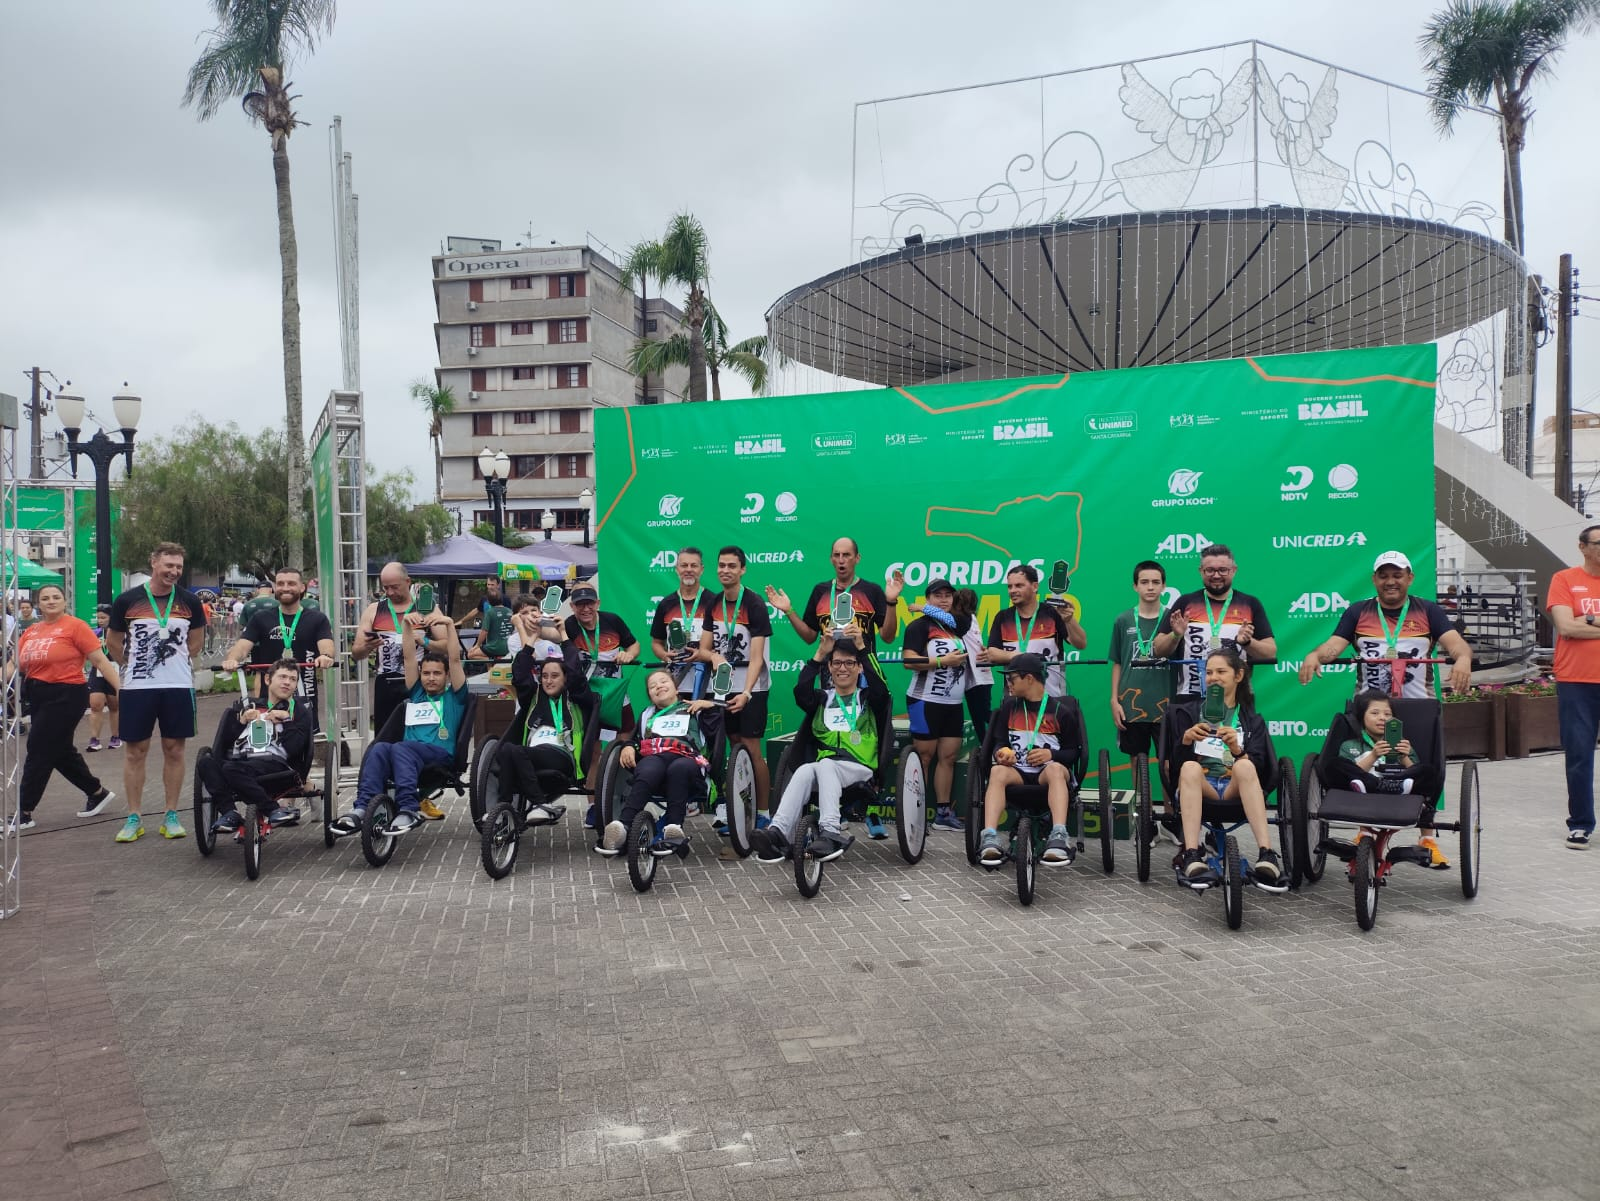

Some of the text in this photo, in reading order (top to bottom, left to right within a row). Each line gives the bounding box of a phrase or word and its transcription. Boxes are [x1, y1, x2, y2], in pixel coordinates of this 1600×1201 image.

[1298, 400, 1369, 420] BRASIL
[993, 422, 1053, 440] BRASIL
[1098, 420, 1133, 430] UNIMED
[734, 438, 786, 455] BRASIL
[823, 439, 853, 448] UNIMED
[1151, 496, 1214, 508] GRUPO KOCH
[1281, 492, 1308, 501] NDTV
[1328, 491, 1359, 500] RECORD
[671, 519, 692, 527] KOCH
[740, 515, 760, 524] NDTV
[1272, 533, 1345, 549] UNICRED
[649, 550, 678, 568] AD
[745, 551, 787, 564] NICRED
[884, 558, 1045, 588] CORRIDAS
[1288, 591, 1350, 613] ADA
[132, 623, 148, 680] ACORVALI
[380, 634, 391, 673] ACORVA
[1188, 625, 1204, 694] ACOVALI
[930, 640, 949, 696] ACVALI
[1274, 660, 1347, 673] UNRED
[415, 708, 434, 718] 227
[832, 714, 847, 724] 22
[661, 720, 681, 729] 233
[538, 730, 558, 738] 234
[1083, 810, 1101, 833] 5
